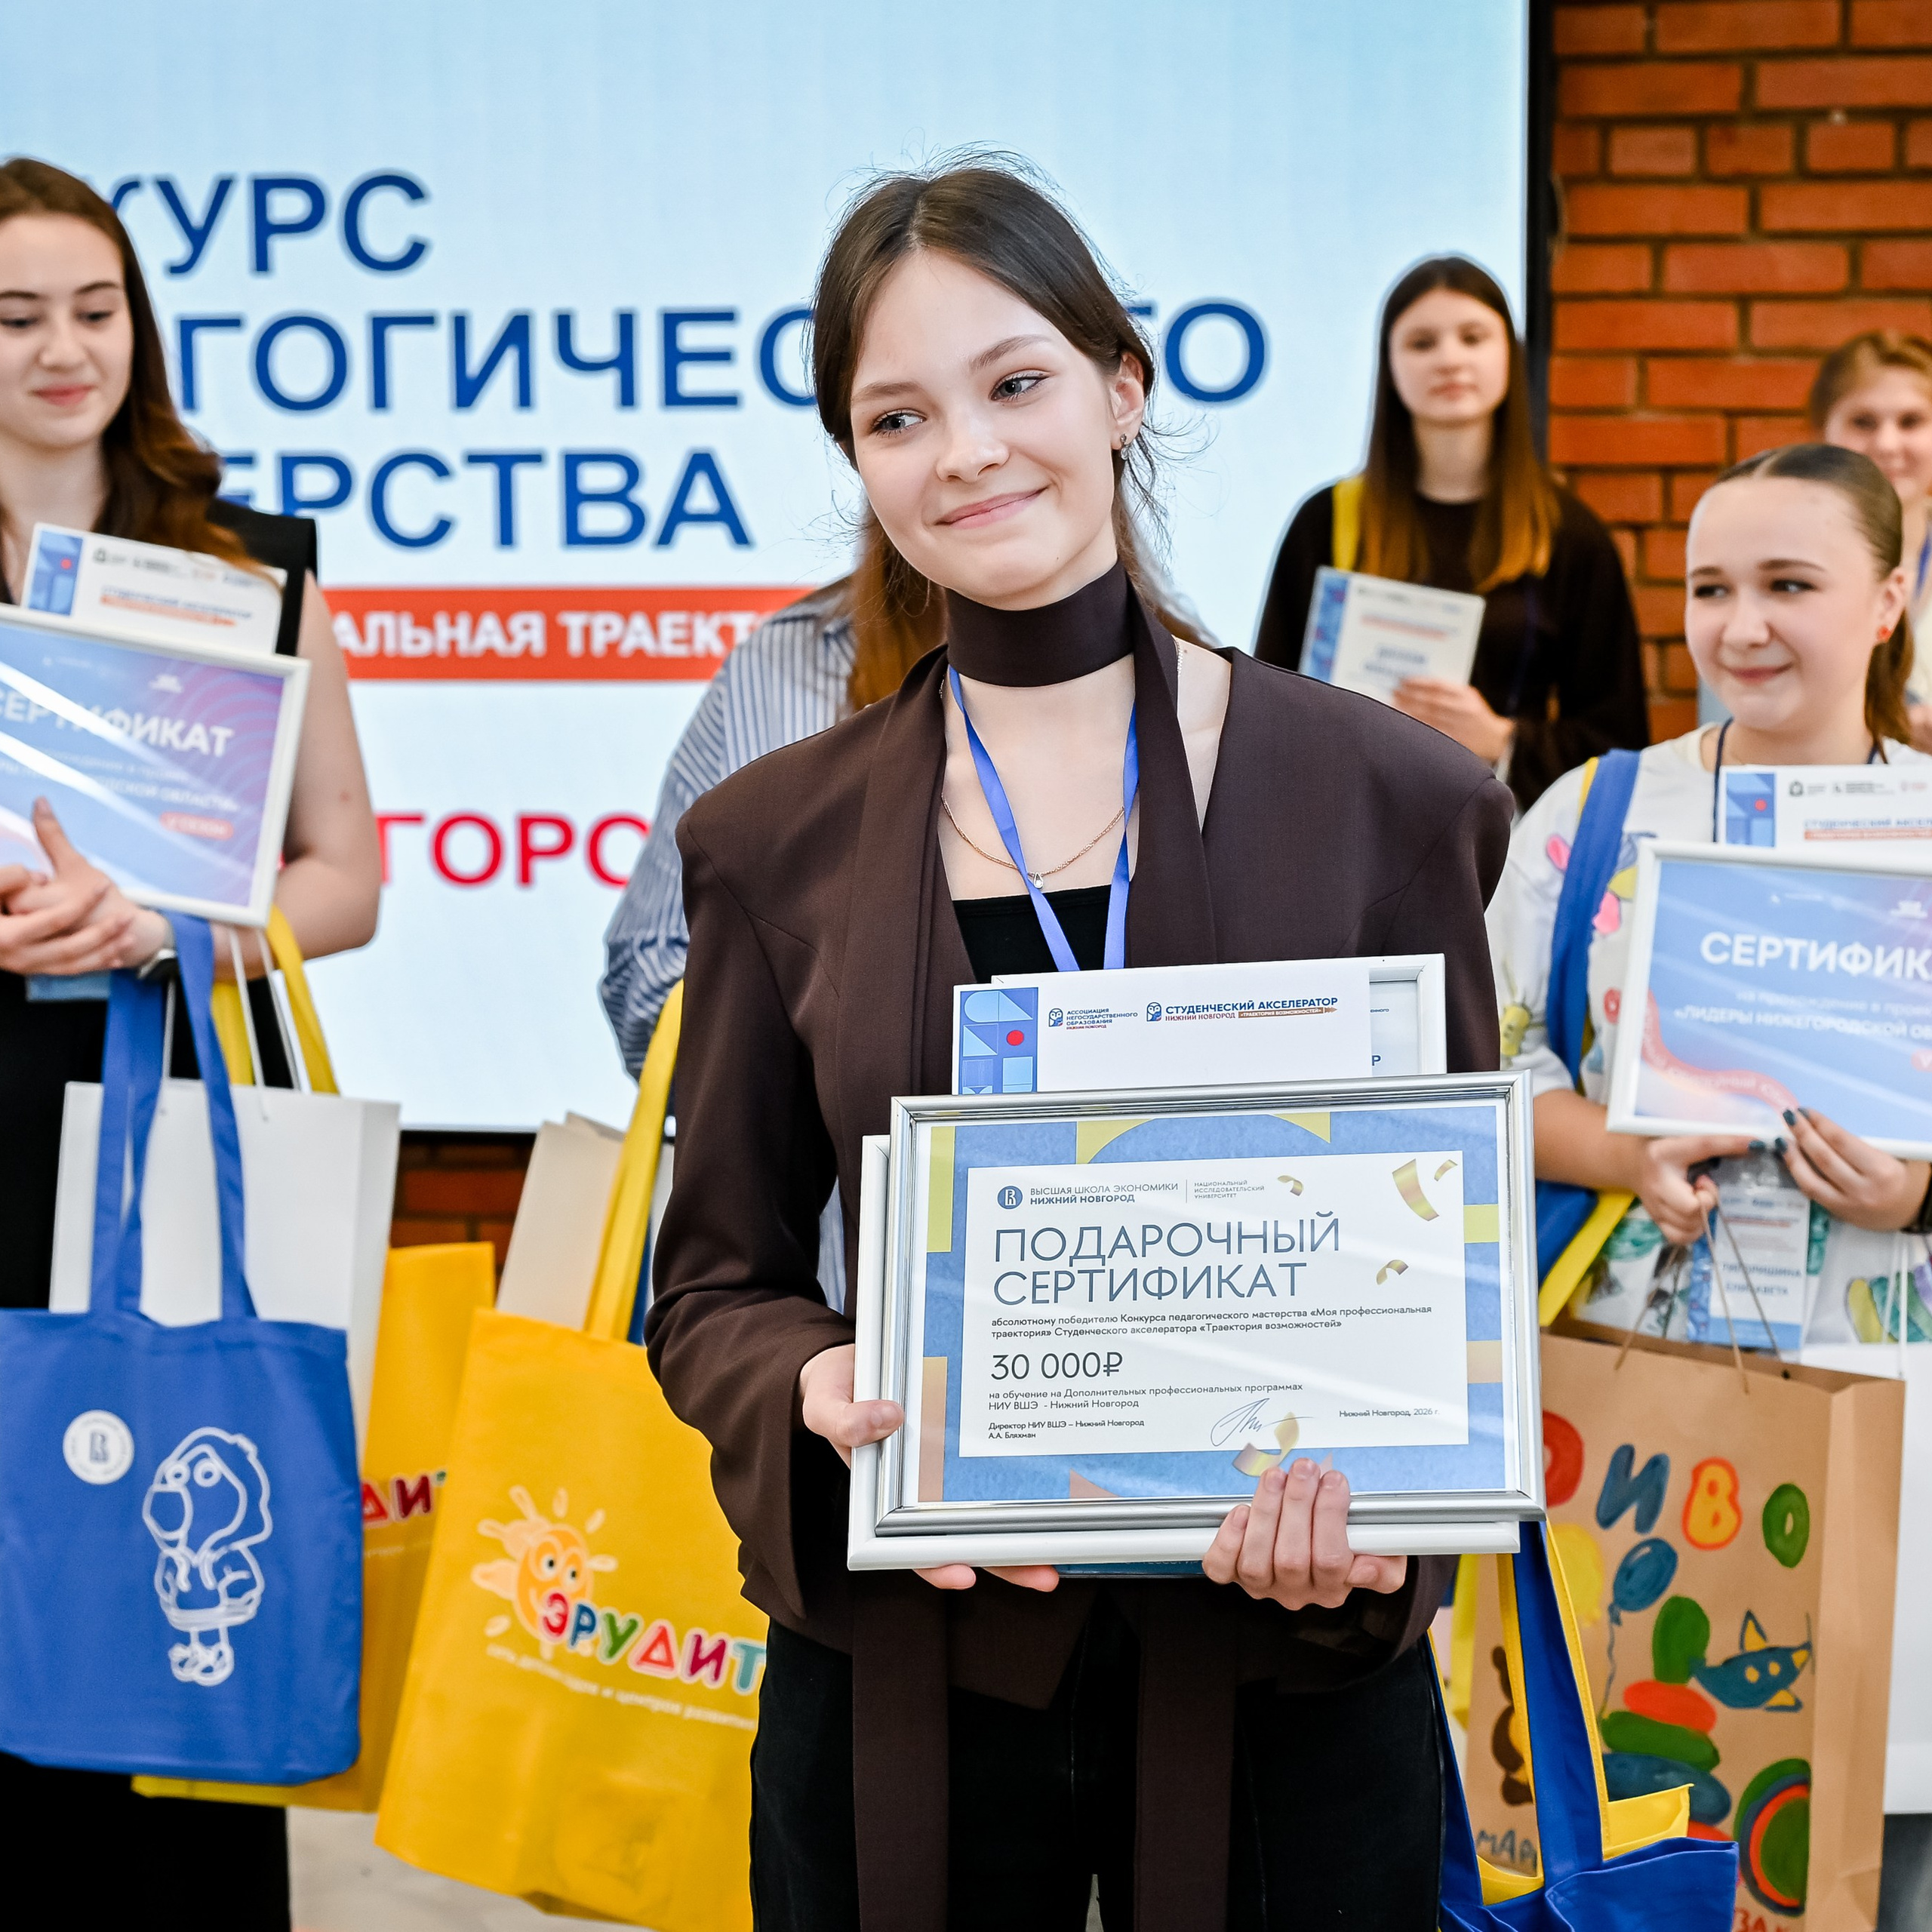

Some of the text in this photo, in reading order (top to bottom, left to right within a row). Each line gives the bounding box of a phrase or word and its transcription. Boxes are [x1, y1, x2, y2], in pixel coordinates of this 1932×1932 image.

[556, 611, 771, 657] ТРАЕКТ
[1166, 997, 1338, 1014] СТУДЕНЧЕСКИЙ АКСЕЛЕРАТОР
[1066, 1012, 1138, 1020] НЕГОСУДАРСТВЕННОГО
[1030, 1183, 1178, 1195] ВЫСШАЯ ШКОЛА ЭКОНОМИКИ
[1030, 1194, 1135, 1205] НИЖНИЙ НОВГОРОД
[995, 1211, 1339, 1267] ПОДАРОЧНЫЙ
[994, 1263, 1307, 1306] СЕРТИФИКАТ
[992, 1306, 1432, 1327] абсолютному победителю Конкурса педагогического мастерства «Моя профессиональная
[992, 1320, 1341, 1339] траектория» Студенческого акселератора «Траектория возможностей»
[991, 1352, 1123, 1380] 30 000₽
[1003, 1391, 1048, 1401] обучение
[1064, 1389, 1146, 1398] Дополнительных
[1149, 1386, 1241, 1396] профессиональных
[1244, 1383, 1303, 1394] программах
[989, 1402, 1011, 1411] НИУ
[1014, 1401, 1038, 1410] ВШЭ
[1050, 1401, 1089, 1409] Нижний
[1091, 1400, 1139, 1408] Новгород
[1372, 1409, 1411, 1417] Новгород,
[989, 1422, 1026, 1431] Директор
[363, 1470, 446, 1519] ДИ
[541, 1592, 767, 1692] ЭРУДИТ
